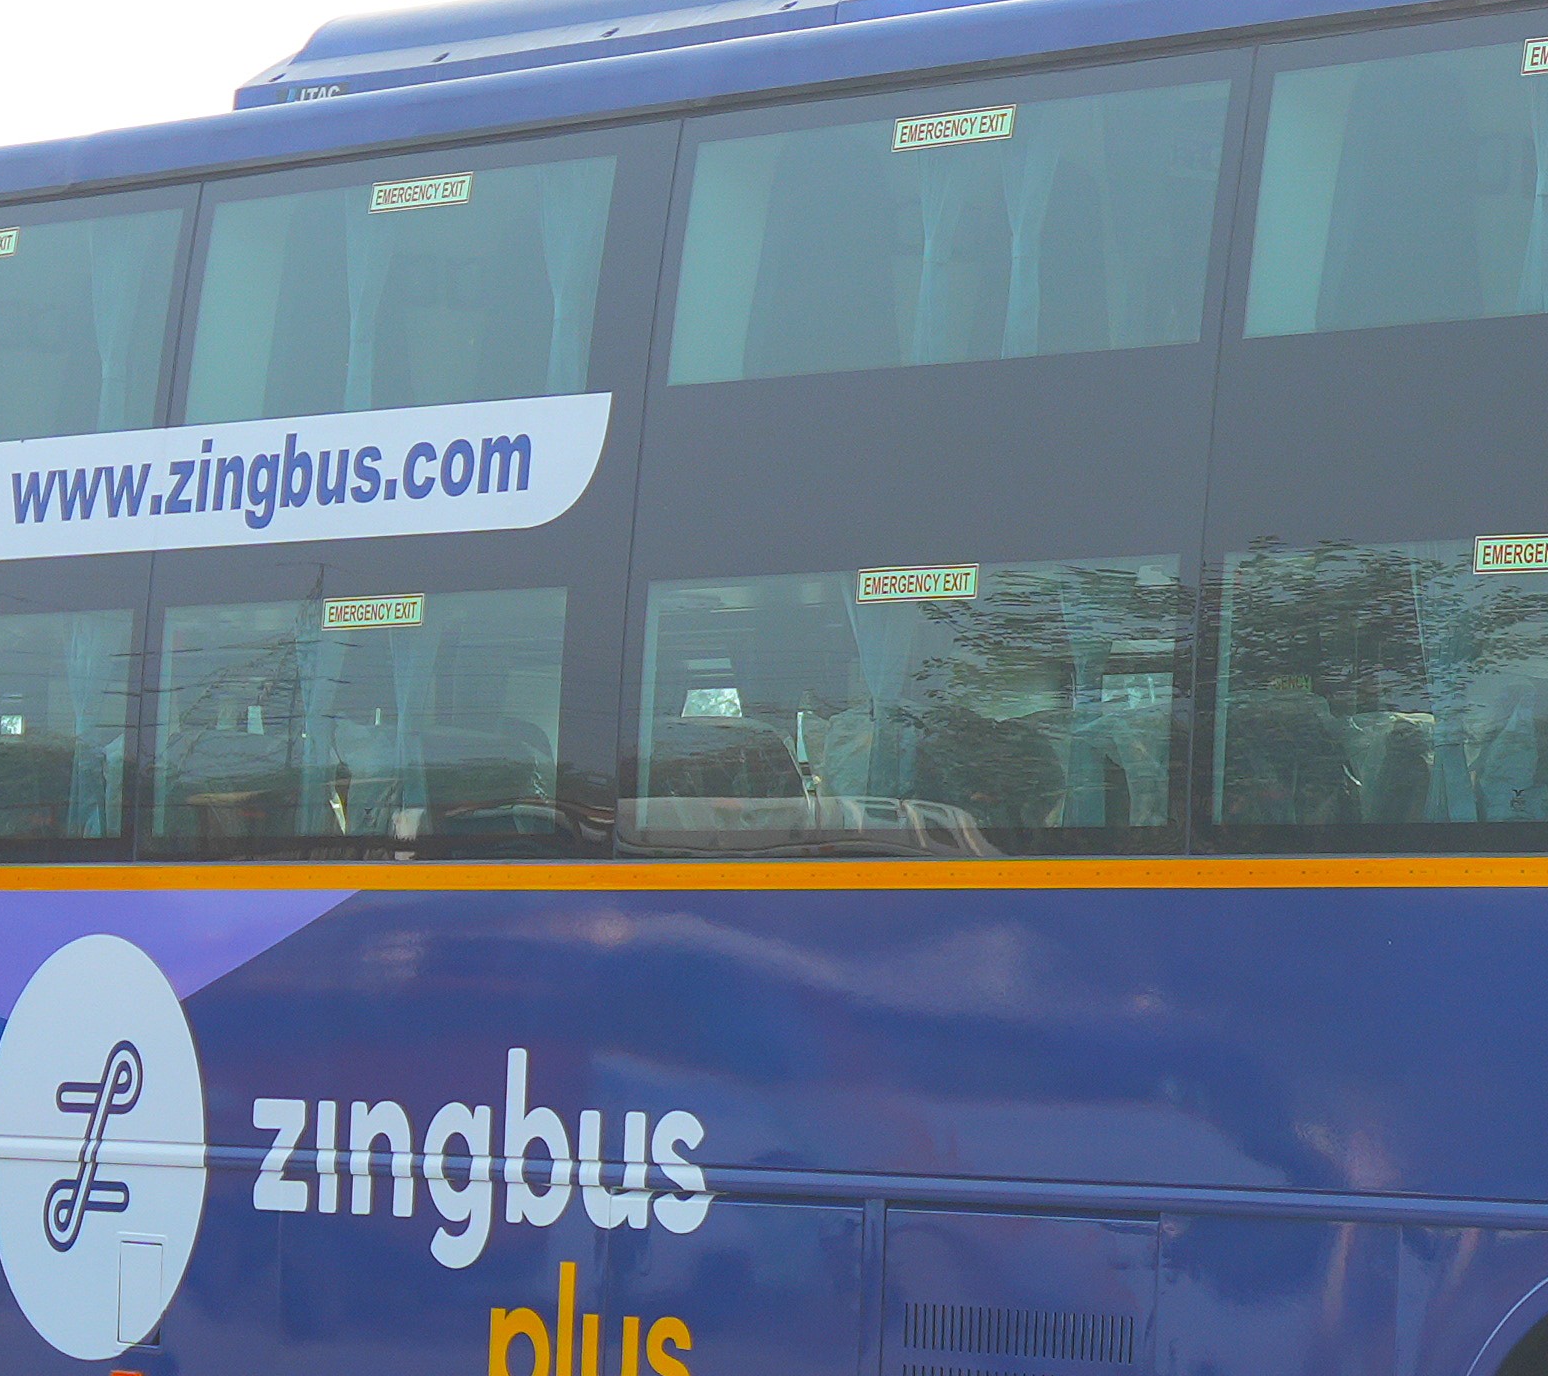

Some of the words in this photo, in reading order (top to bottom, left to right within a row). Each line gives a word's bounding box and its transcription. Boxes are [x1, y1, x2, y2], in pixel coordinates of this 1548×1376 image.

[900, 117, 977, 144] EMERGENCY
[979, 113, 1007, 133] EXIT
[376, 182, 442, 205] EMERGENCY
[442, 180, 465, 197] EXIT
[12, 432, 532, 531] www.zingbus.com
[864, 574, 941, 596] EMERGENCY
[943, 572, 971, 592] EXIT
[328, 603, 392, 623] EMERGENCY
[394, 602, 417, 620] EXIT
[253, 1047, 709, 1269] zingbus
